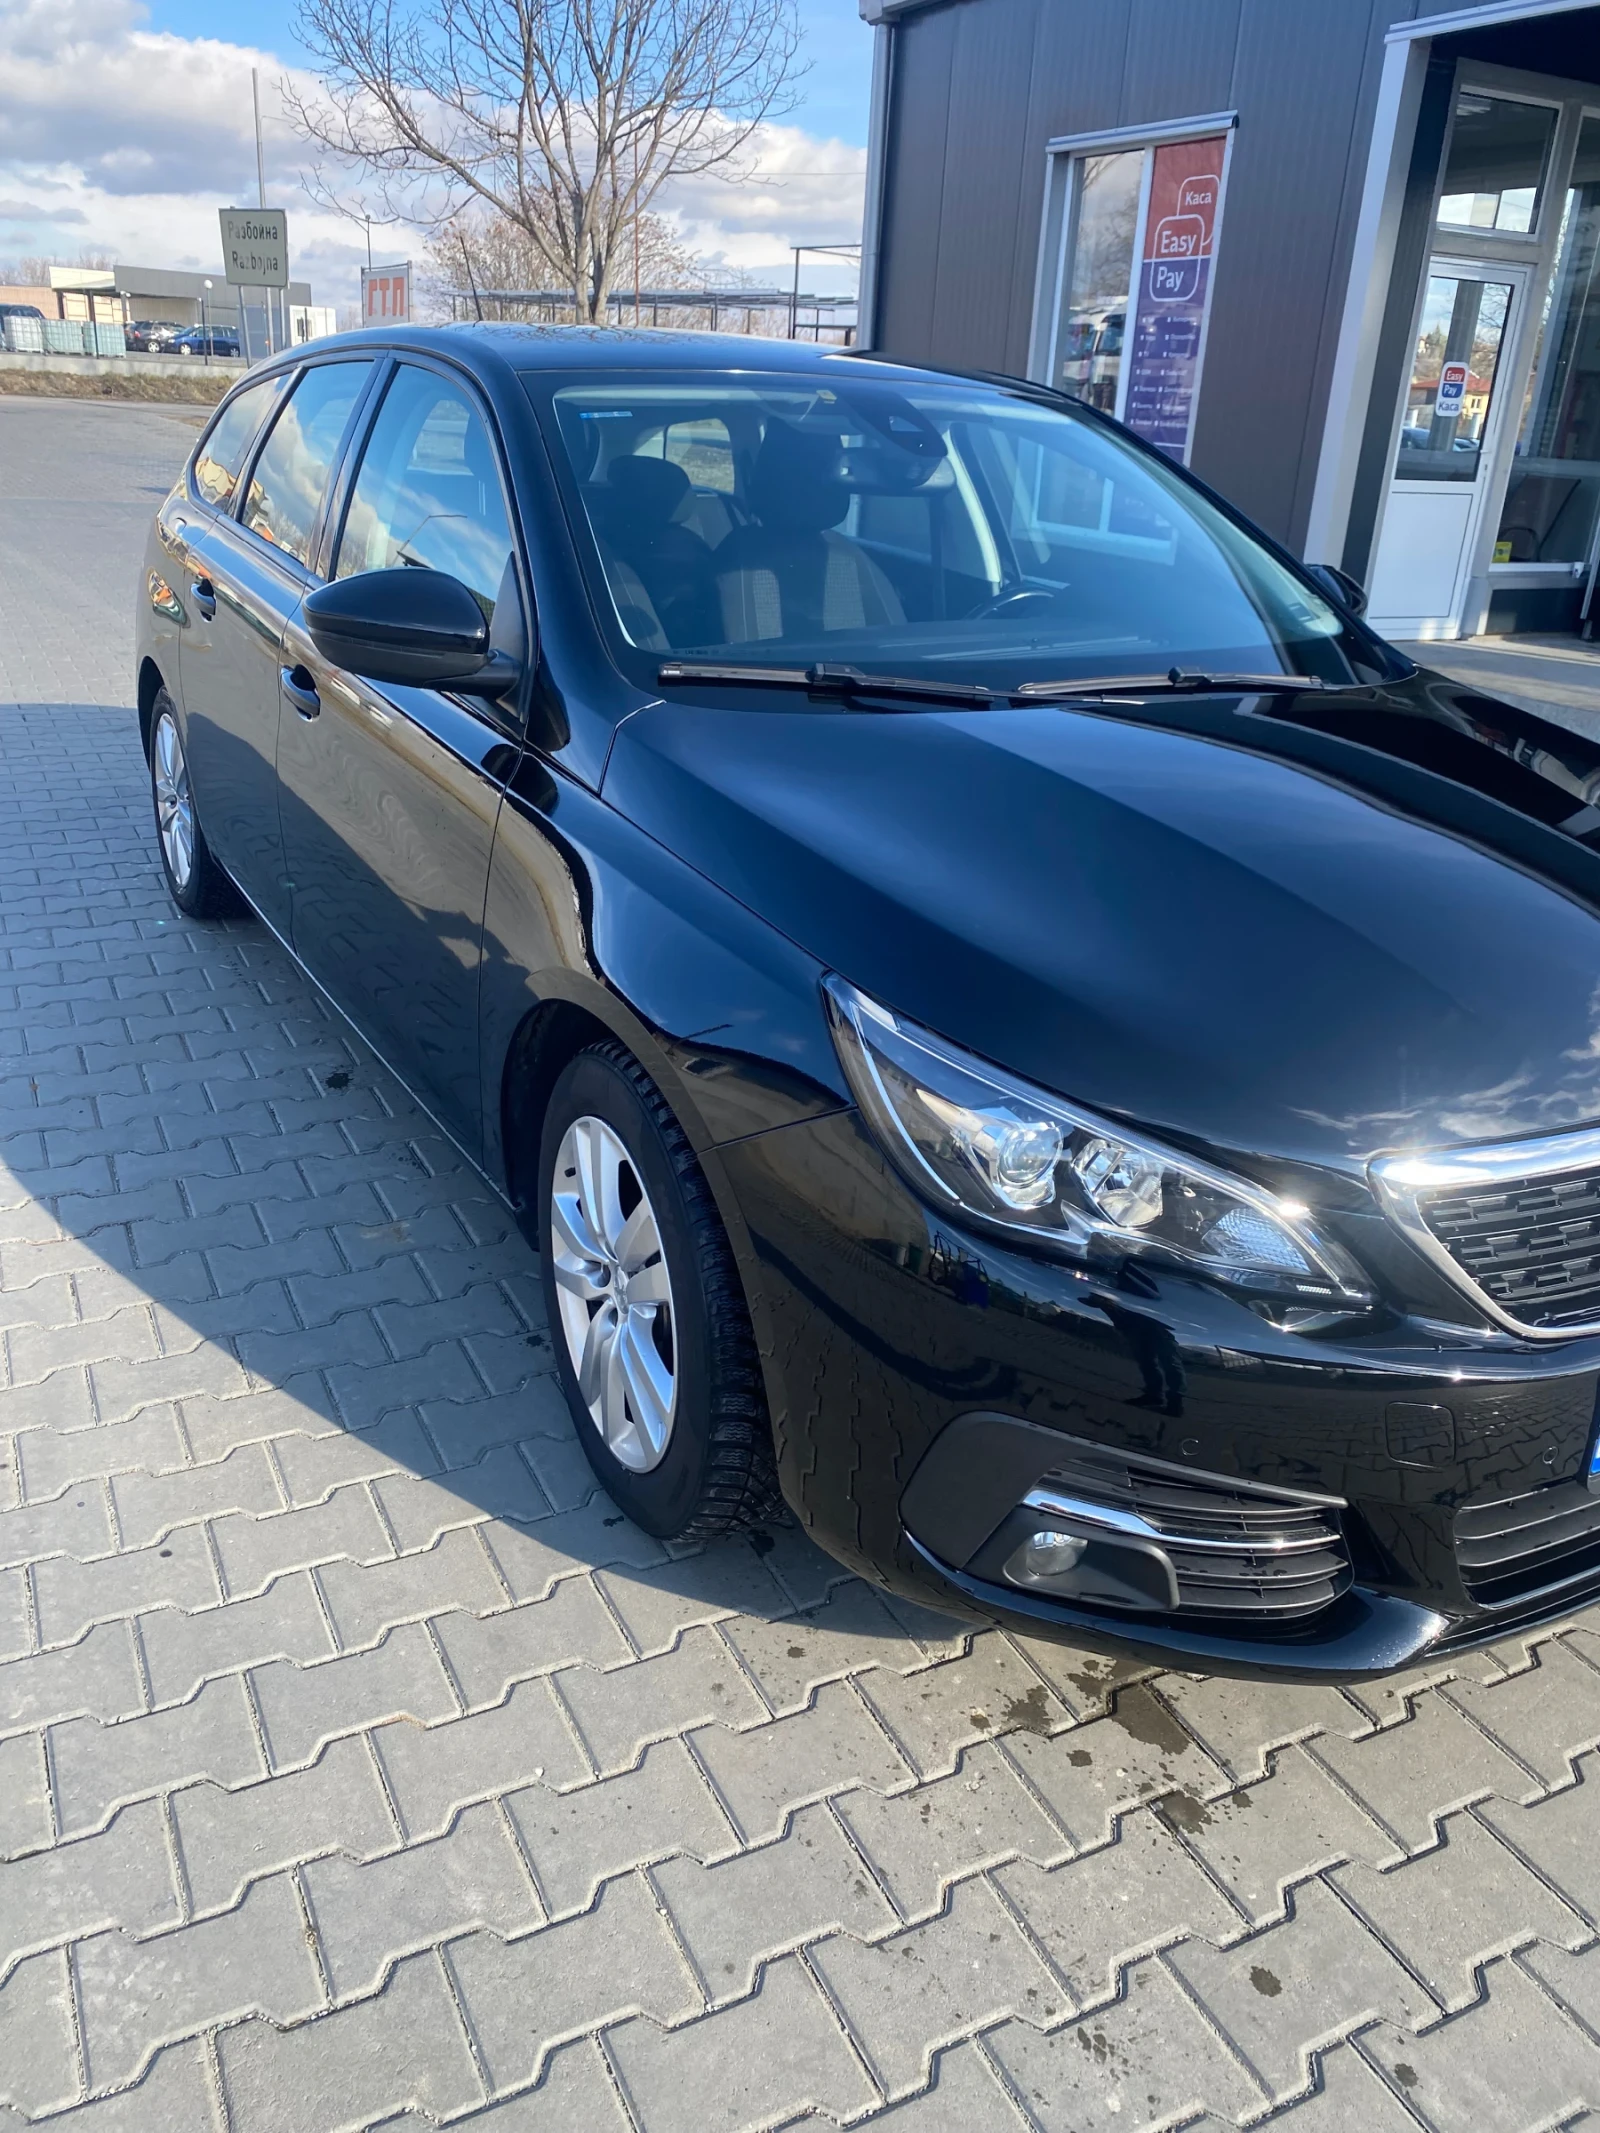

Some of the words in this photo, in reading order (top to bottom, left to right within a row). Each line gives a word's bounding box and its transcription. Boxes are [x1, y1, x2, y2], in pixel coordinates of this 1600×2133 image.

[1185, 191, 1212, 206] Каса
[227, 220, 278, 240] Разбойна
[1160, 230, 1198, 256] Easy
[231, 250, 278, 276] Razbojna
[1156, 266, 1184, 292] Pay
[367, 276, 405, 317] ГТП
[1446, 370, 1463, 382] Easy
[1443, 384, 1457, 396] Pay
[1438, 401, 1459, 411] Каса
